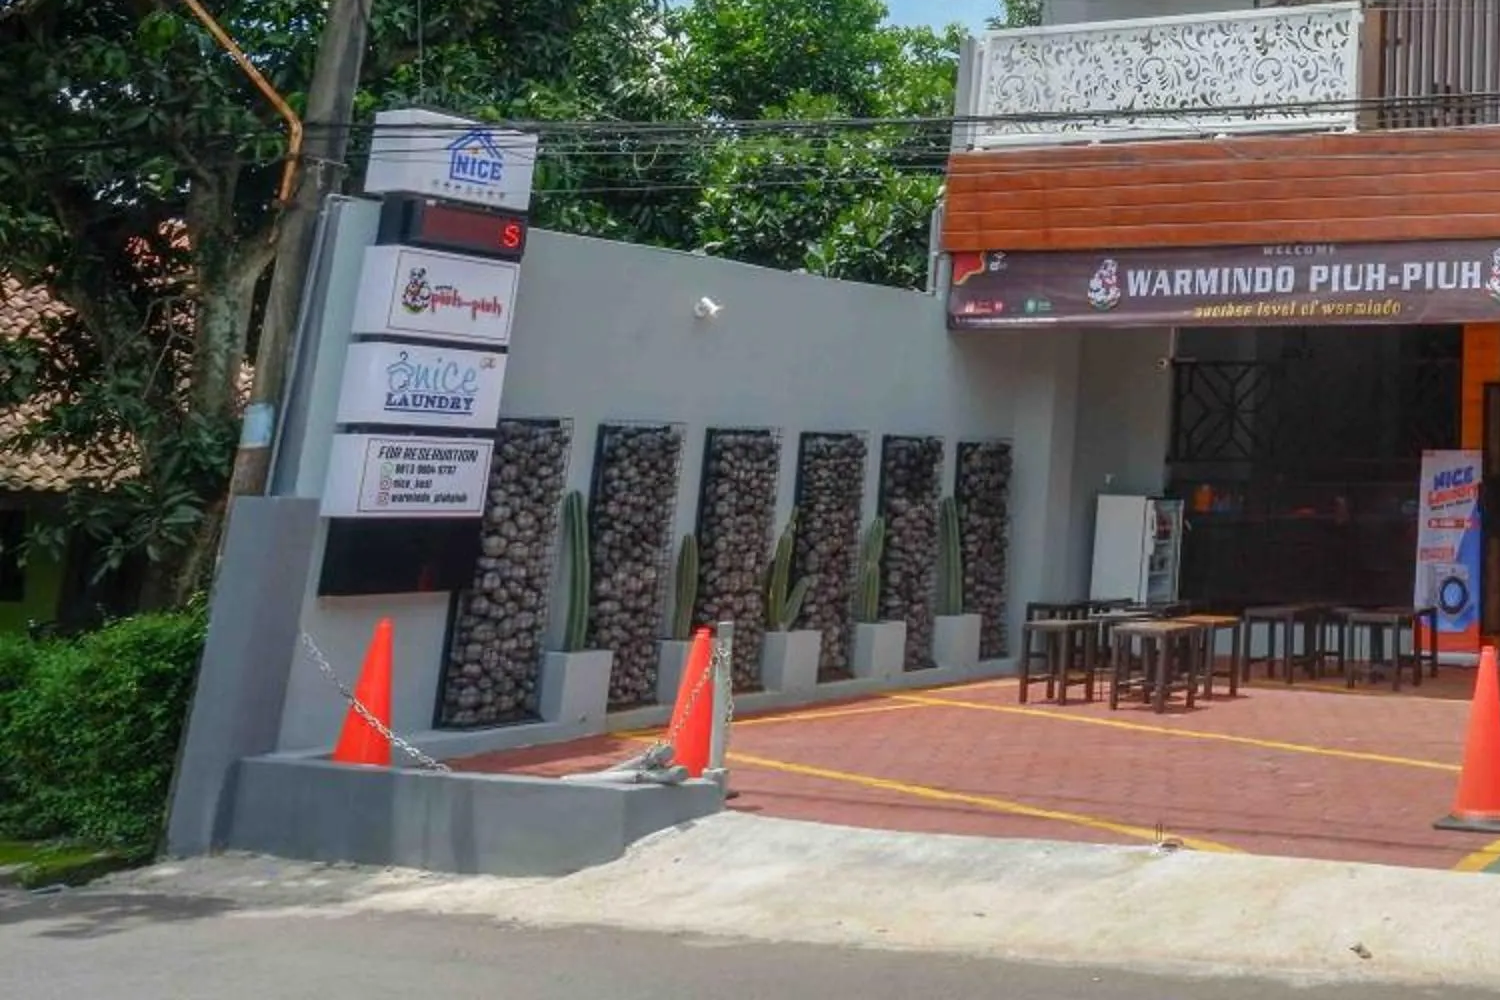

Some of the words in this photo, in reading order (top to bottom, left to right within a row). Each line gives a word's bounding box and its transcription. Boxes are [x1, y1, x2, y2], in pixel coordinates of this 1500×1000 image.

[455, 155, 503, 181] NICE
[503, 223, 520, 248] S
[1263, 244, 1336, 256] WELCOME
[1128, 265, 1295, 297] WARMINDO
[1309, 260, 1482, 293] PIUH-PIUH
[1257, 301, 1297, 317] level
[1300, 300, 1319, 316] of
[414, 357, 479, 393] nice
[385, 392, 475, 411] LAUNDRY
[378, 446, 403, 459] FOR
[1433, 465, 1474, 490] NICE
